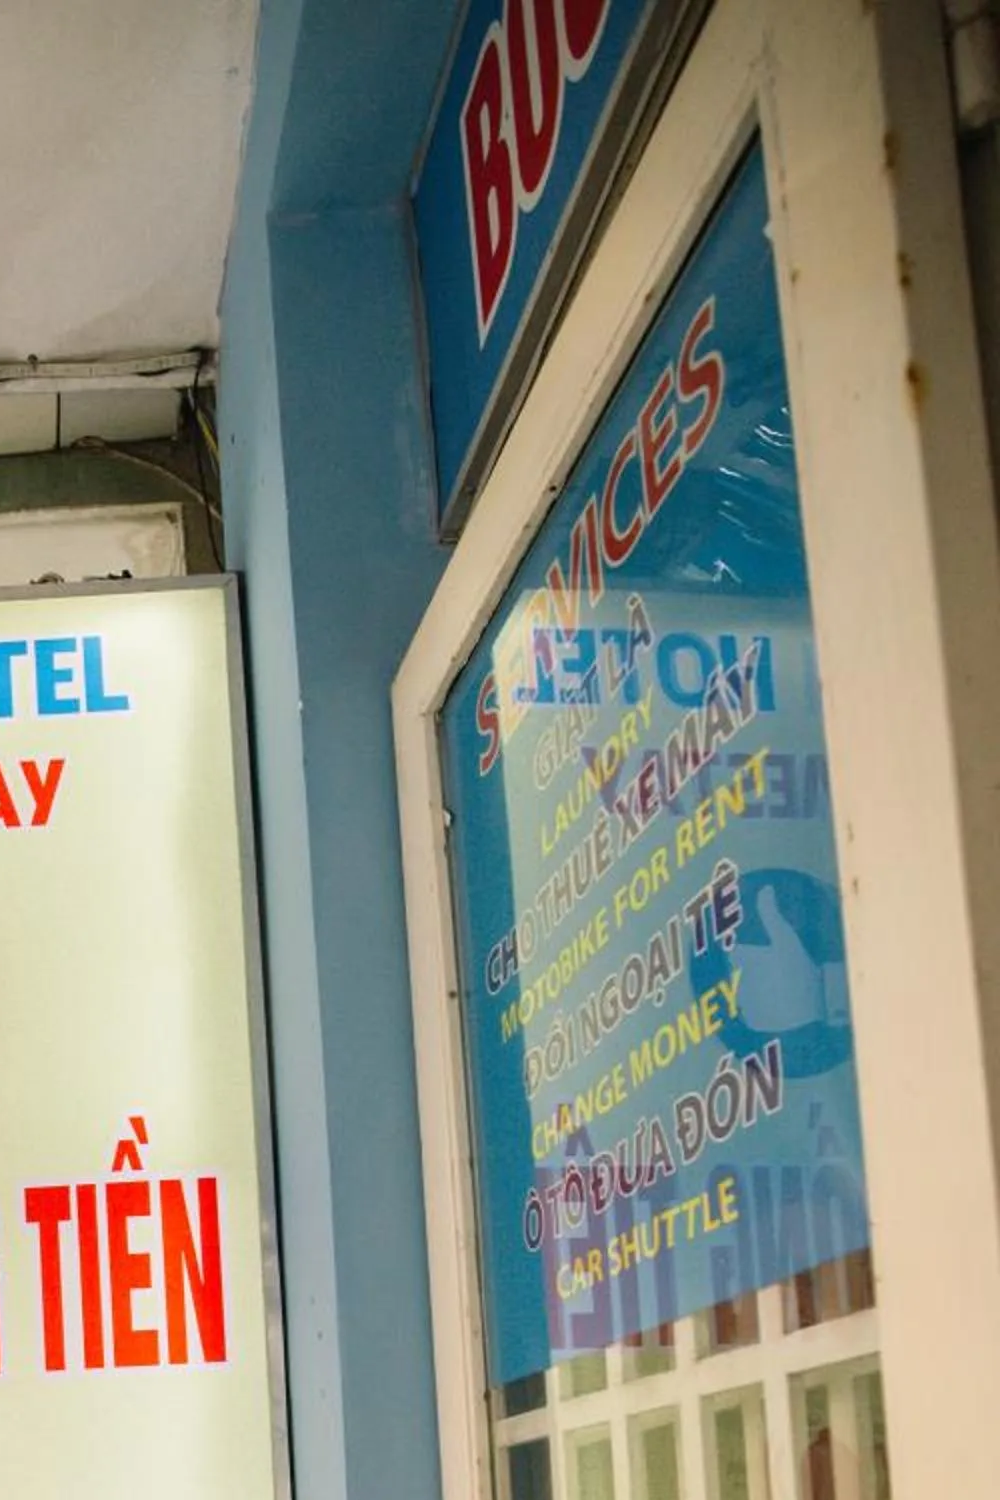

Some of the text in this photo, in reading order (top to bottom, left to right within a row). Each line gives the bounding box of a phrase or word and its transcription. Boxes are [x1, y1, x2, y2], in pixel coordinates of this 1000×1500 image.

[462, 0, 606, 345] BU
[476, 296, 726, 776] SERVICES
[486, 908, 539, 995] CHO
[613, 752, 663, 858] XE
[540, 684, 653, 856] LAUNDRY
[501, 745, 771, 1043] MOTOBIKE FOR RENT
[682, 857, 744, 957] TỆ
[531, 969, 743, 1160] CHANGE MONEY
[673, 1038, 784, 1165] ĐÓN
[24, 1116, 228, 1372] TIỀN
[556, 1176, 740, 1300] CAR SHUTTLE
